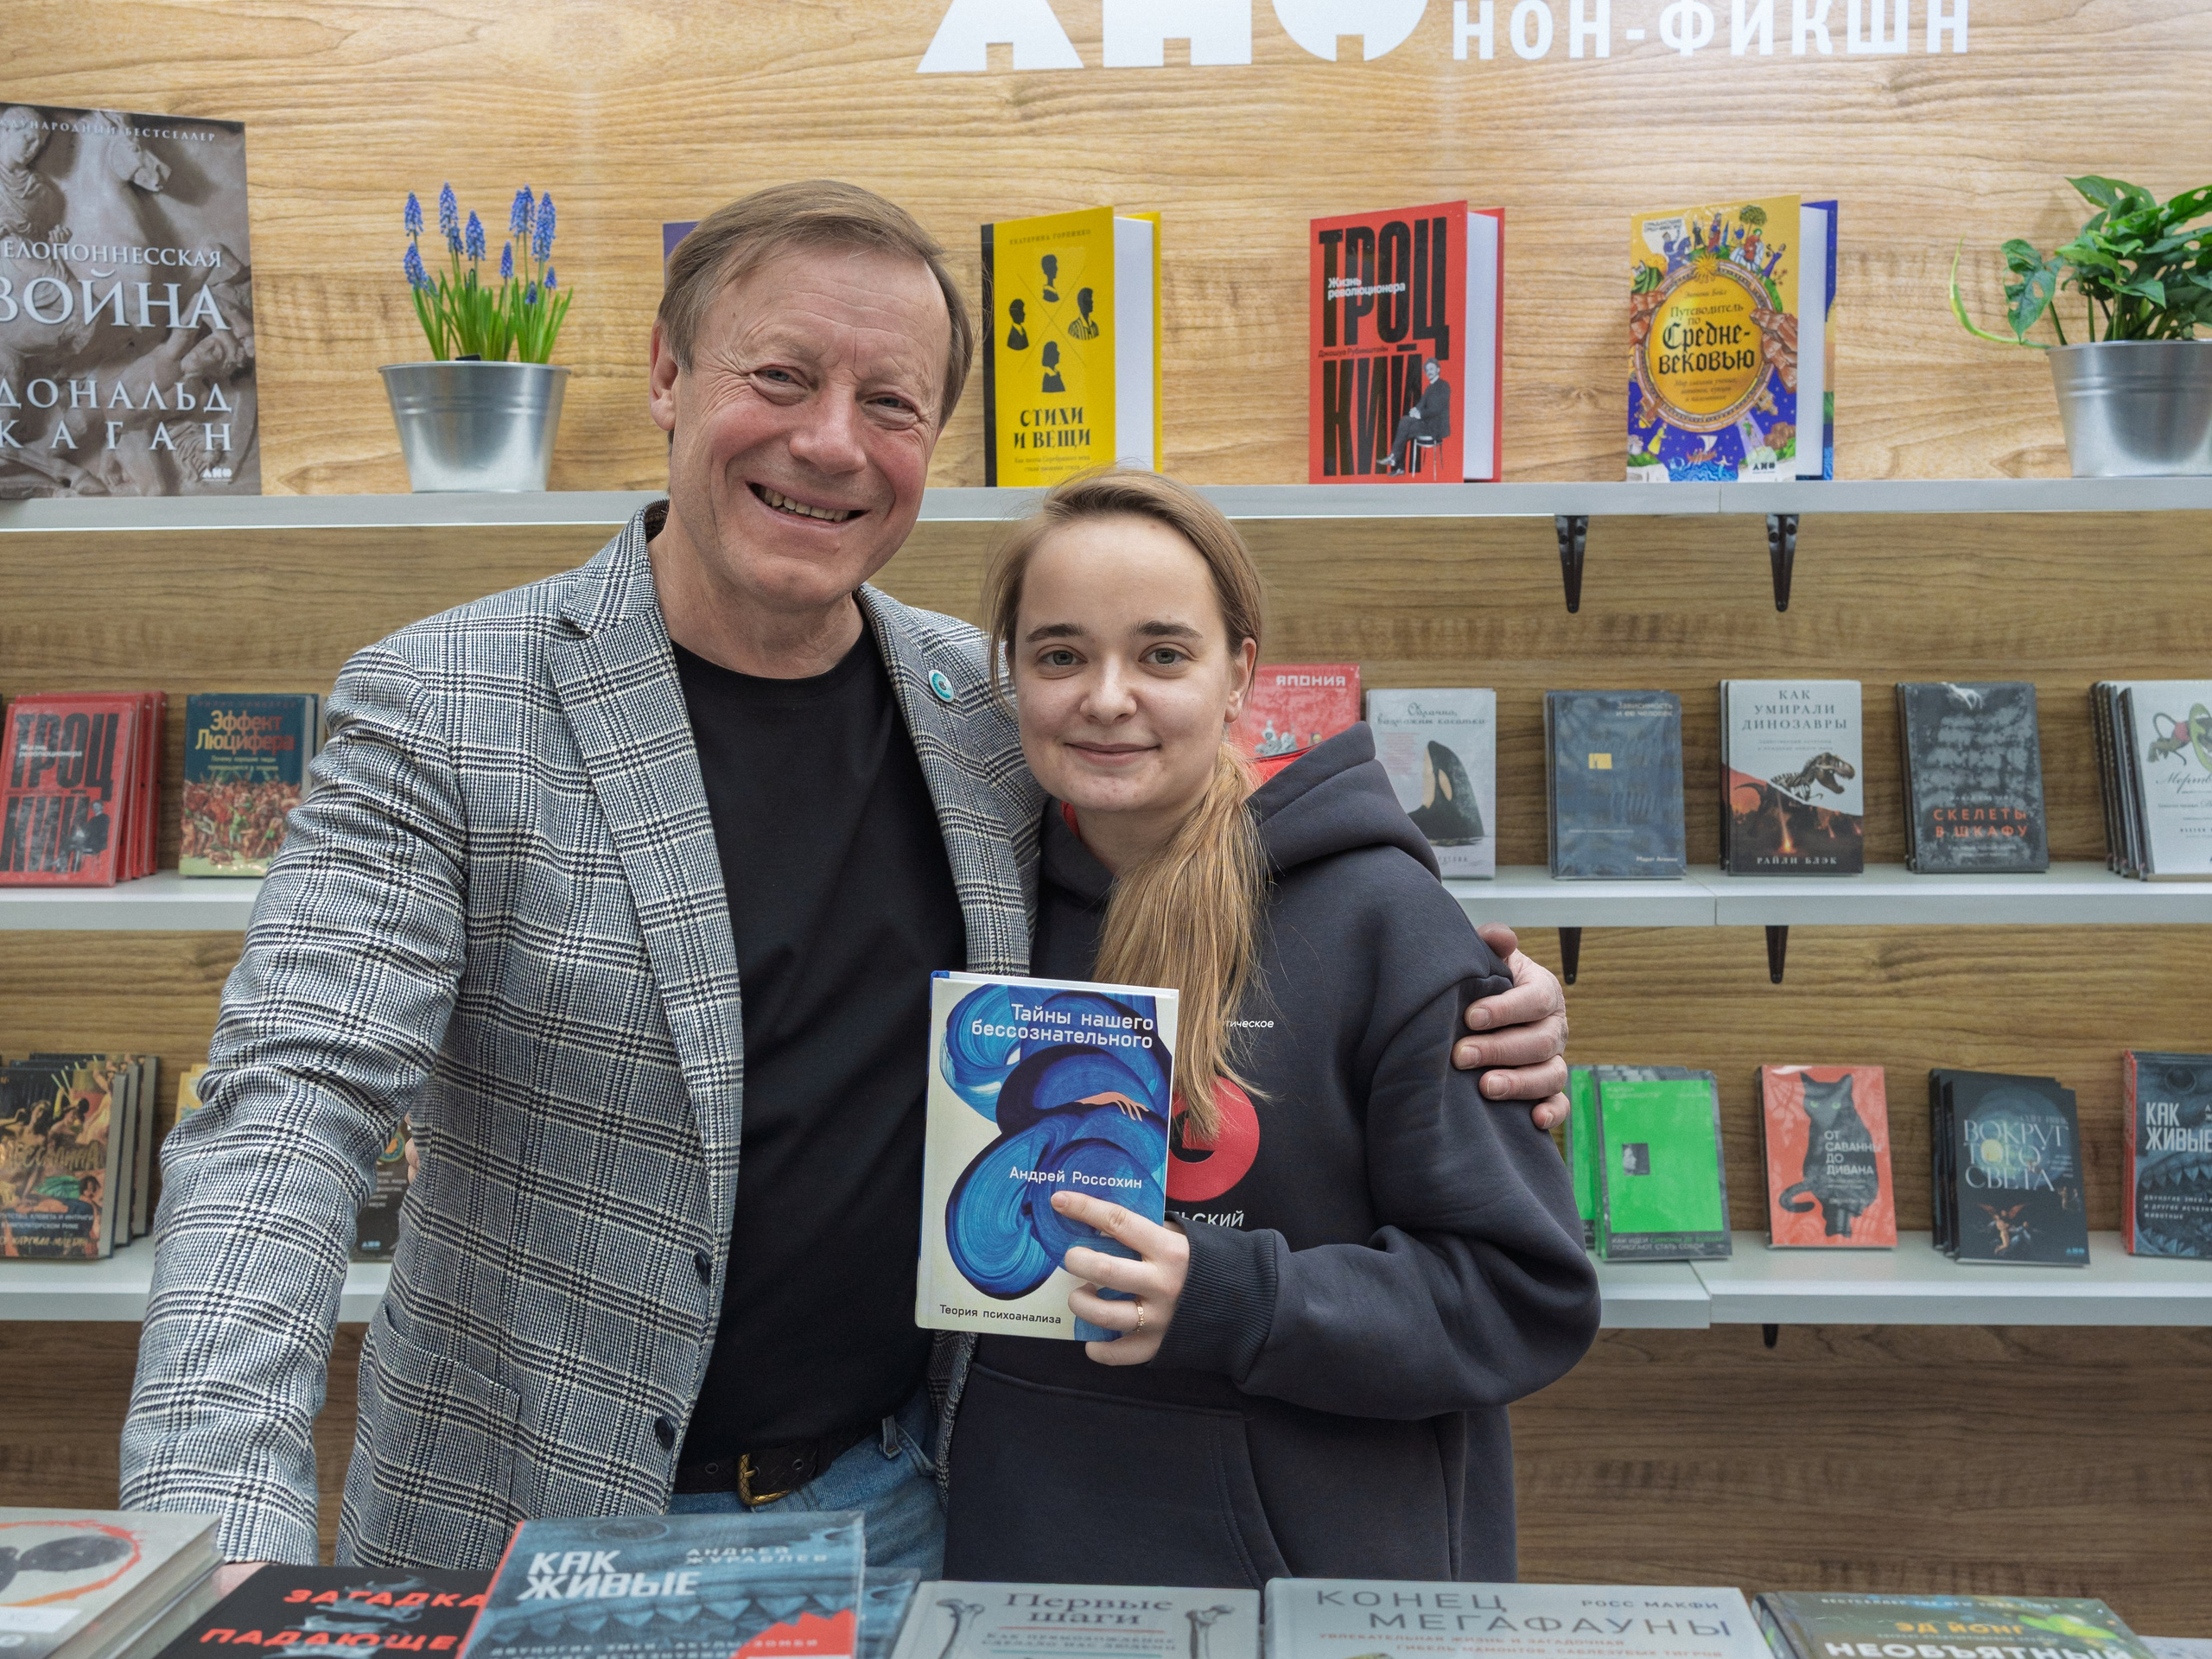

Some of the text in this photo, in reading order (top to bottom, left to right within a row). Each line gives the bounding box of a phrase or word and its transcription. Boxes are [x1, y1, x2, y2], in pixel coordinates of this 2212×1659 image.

[1452, 0, 1968, 60] НОН-ФИКШН
[125, 127, 216, 143] БЕСТСЕЛЛЕР
[1319, 216, 1450, 360] ТРОЦ
[1327, 282, 1407, 301] революционера
[1328, 276, 1363, 289] Жизнь
[1670, 303, 1745, 321] Путеводитель
[1688, 316, 1701, 326] по
[1662, 321, 1751, 353] Средне-
[1658, 348, 1756, 375] вековью
[0, 378, 232, 414] ДОНАЛЬД
[1020, 406, 1084, 427] СТИХИ
[0, 418, 233, 452] КАГАН
[1014, 428, 1090, 451] И ВЕЩИ
[1276, 675, 1346, 687] ЯПОНИЯ
[1778, 690, 1811, 700] КАК
[1754, 704, 1835, 715] УМИРАЛИ
[209, 709, 283, 736] Эффект
[1742, 719, 1847, 731] ДИНОЗАВРЫ
[194, 728, 296, 757] Люцифера
[10, 712, 119, 802] ТРОЦ
[1933, 807, 2027, 821] СКЕЛЕТЫ
[1936, 824, 2028, 838] В ШКАФУ
[1757, 855, 1838, 865] РАЙЛИ БЛЭК
[1010, 1003, 1154, 1031] Тайны нашего
[971, 1019, 1153, 1049] бессознательного
[2145, 1102, 2180, 1127] КАК
[1823, 1129, 1840, 1141] ОТ
[1963, 1119, 2069, 1150] ВОКРУГ
[2145, 1126, 2212, 1153] ЖИВЫЕ
[1825, 1141, 1883, 1153] САВАННЫ
[1963, 1141, 2041, 1167] ТОГО
[1826, 1153, 1845, 1165] ДО
[1009, 1166, 1142, 1189] Андрей Россохин
[1827, 1164, 1875, 1176] ДИВАНА
[1965, 1165, 2056, 1192] СВЕТА
[1175, 1211, 1244, 1228] ЬСКИЙ
[939, 1304, 1061, 1325] Теория психоанализа
[686, 1545, 790, 1556] АНДРЕЙ
[527, 1550, 621, 1576] КАК
[516, 1570, 702, 1601] ЖИВЫЕ
[283, 1589, 487, 1607] ЗАГАДКА
[1003, 1592, 1174, 1613] Первые
[1317, 1590, 1508, 1613] КОНЕЦ
[1580, 1599, 1719, 1610] РОСС МАКФИ
[1027, 1611, 1141, 1625] шаги
[1370, 1612, 1732, 1636] МЕГАФАУНЫ
[1894, 1621, 2024, 1635] ЭД ЙОНГ
[200, 1628, 464, 1651] ПАДАЮЩЕ
